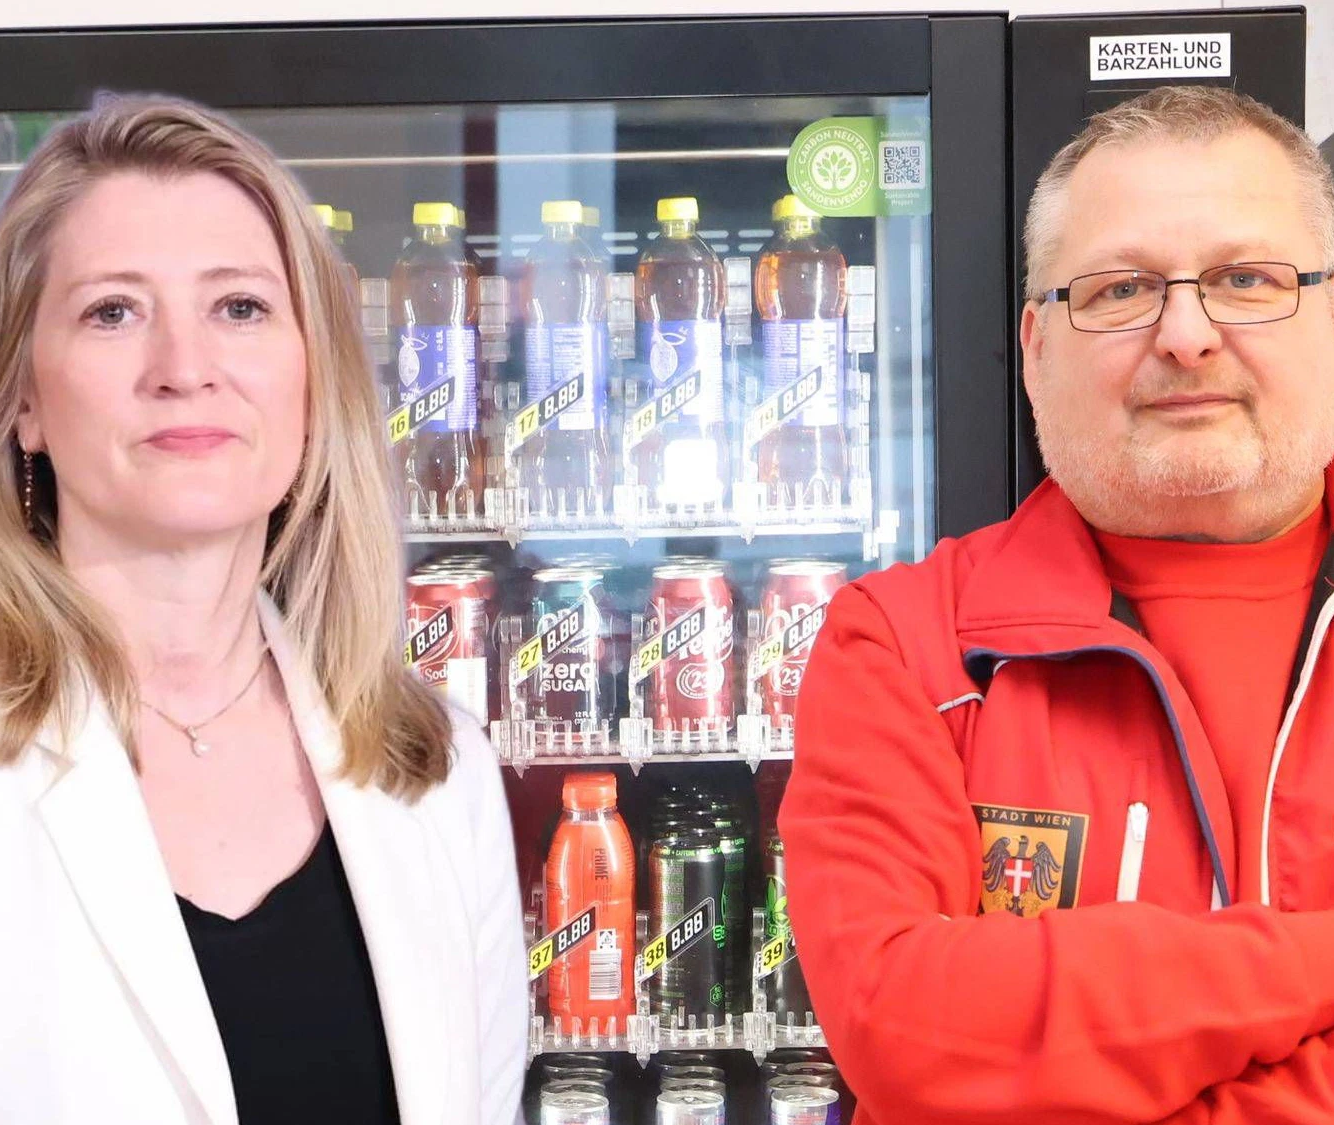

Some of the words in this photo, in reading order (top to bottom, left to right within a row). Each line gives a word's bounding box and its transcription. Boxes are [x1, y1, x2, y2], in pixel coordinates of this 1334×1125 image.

[1097, 55, 1223, 71] BARZAHLUNG
[1098, 41, 1178, 57] KARTEN-
[1184, 40, 1222, 55] UND
[797, 130, 832, 165] CARBON
[832, 129, 871, 162] NEUTRAL
[800, 179, 868, 207] SANDENVENDO
[389, 416, 405, 438] 16
[415, 382, 450, 423] 8.88
[519, 411, 535, 434] 17
[544, 377, 579, 420] 8.88
[635, 409, 653, 432] 18
[661, 376, 696, 418] 8.88
[758, 407, 775, 430] 19
[782, 371, 818, 415] 8.88
[416, 612, 448, 656] 8.88
[520, 643, 540, 670] 27
[546, 611, 579, 653] 8.88
[640, 642, 660, 669] 28
[667, 612, 701, 654] 8.88
[761, 640, 781, 667] 29
[788, 607, 824, 648] 8.88
[424, 667, 449, 683] Sod
[543, 661, 597, 680] zero
[780, 667, 797, 687] 23
[981, 808, 1028, 822] STADT
[1033, 813, 1072, 827] WIEN
[594, 847, 609, 881] PRIME
[531, 943, 552, 970] 37
[558, 912, 591, 952] 8.88
[645, 940, 665, 967] 38
[671, 910, 704, 951] 8.88
[763, 941, 784, 967] 39
